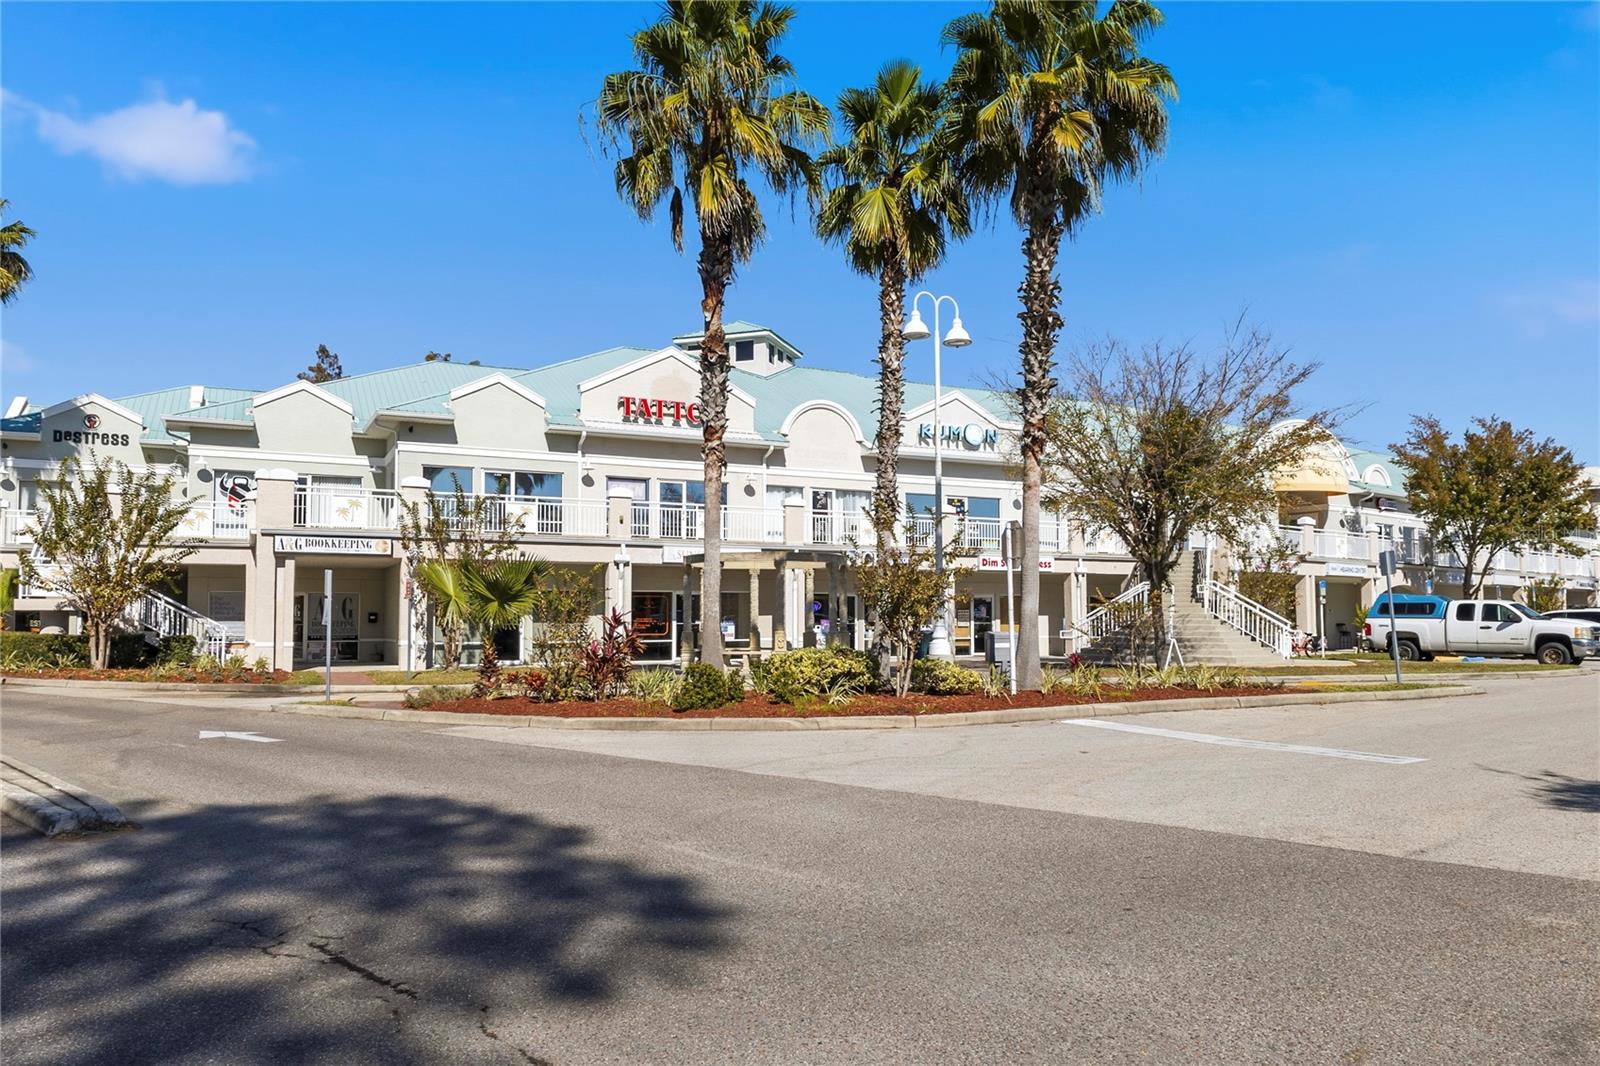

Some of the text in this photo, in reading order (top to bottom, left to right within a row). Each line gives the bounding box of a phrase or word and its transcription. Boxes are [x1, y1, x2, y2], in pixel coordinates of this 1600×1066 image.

[276, 537, 373, 551] A&G BOOKKEEPING
[981, 558, 998, 567] Dim
